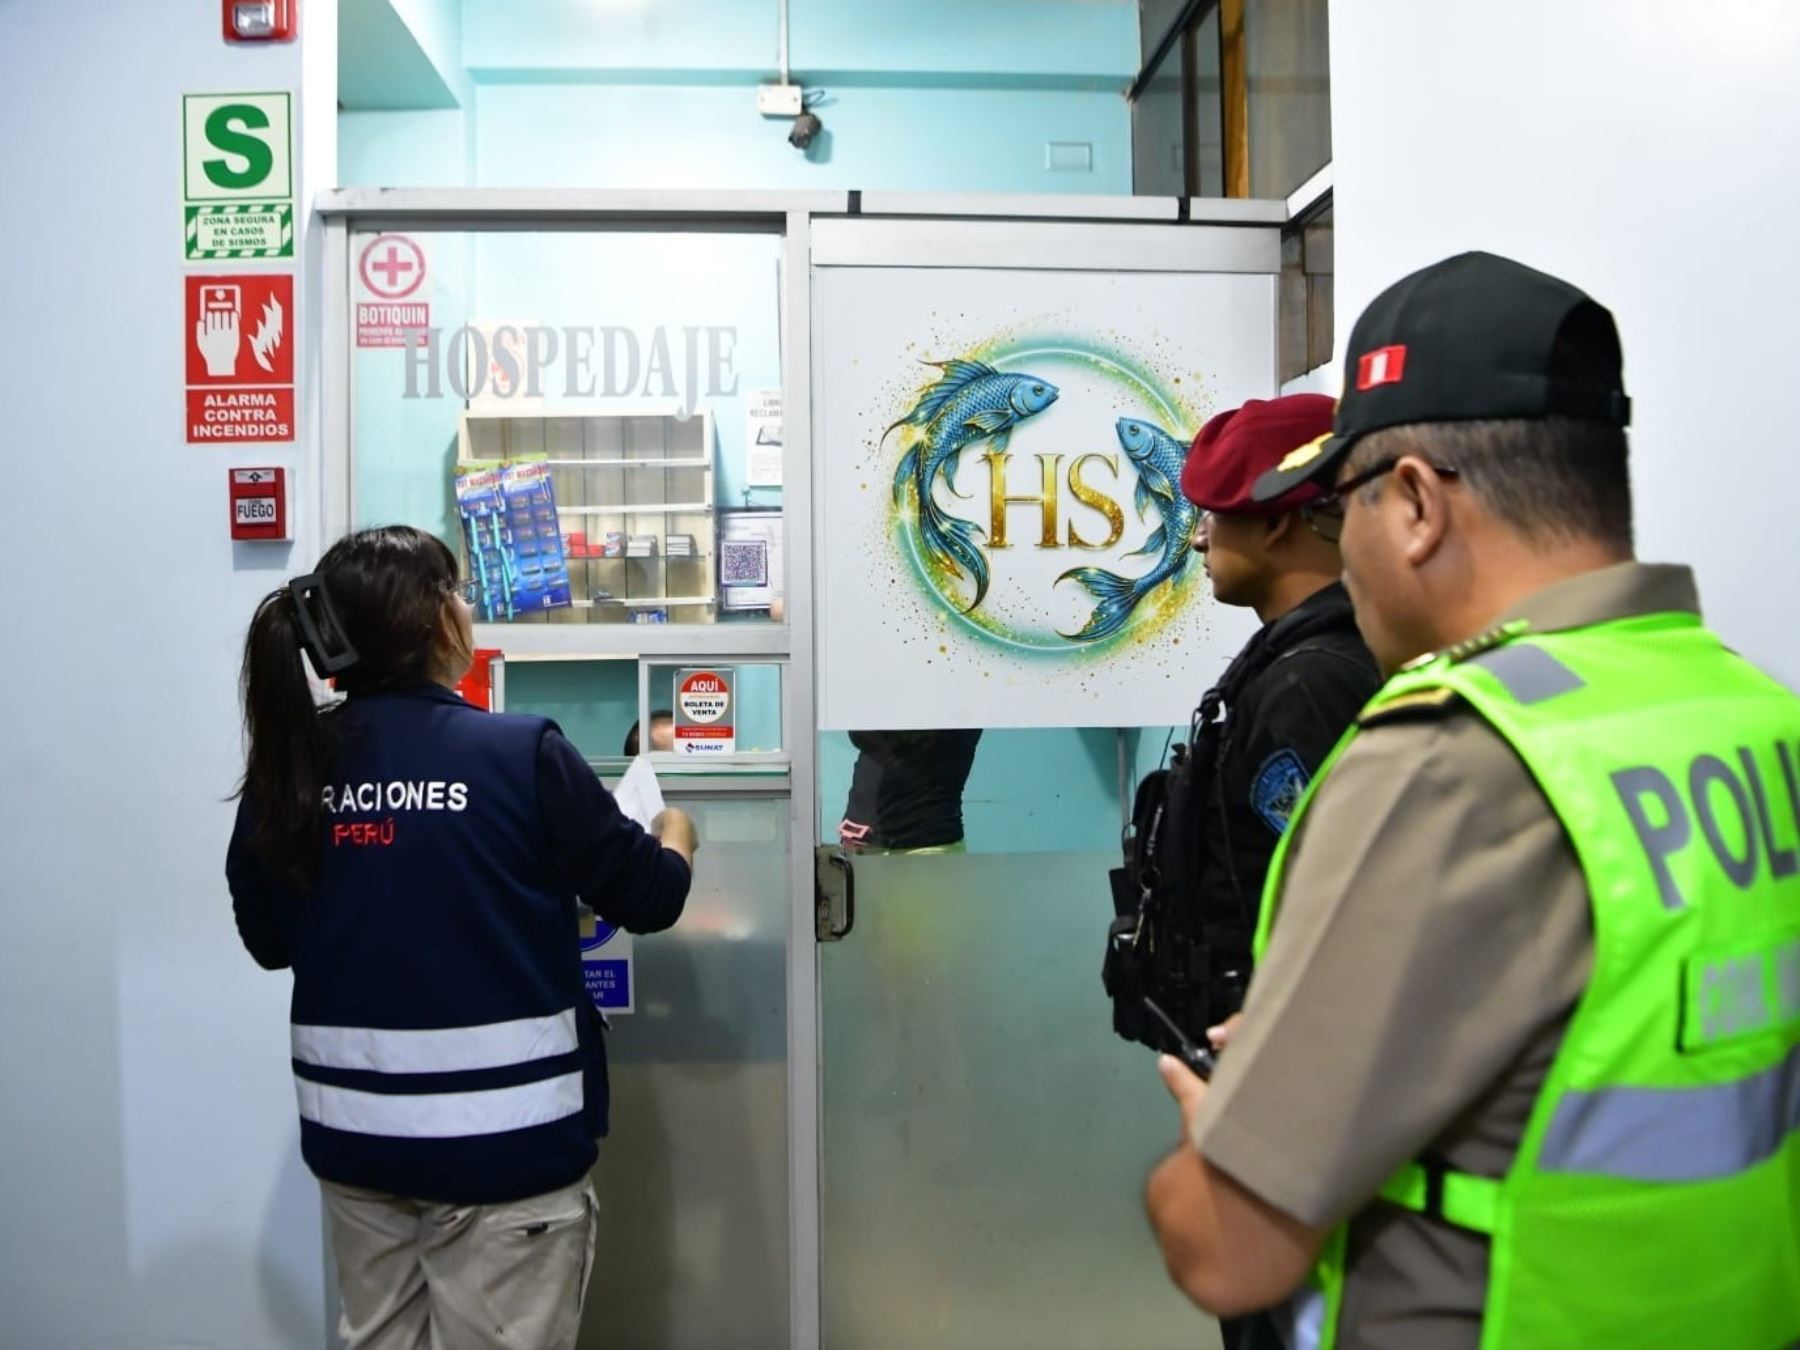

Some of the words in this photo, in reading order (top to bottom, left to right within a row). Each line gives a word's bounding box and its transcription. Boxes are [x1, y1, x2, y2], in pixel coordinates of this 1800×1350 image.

[202, 104, 273, 189] S
[203, 217, 231, 225] ZONA
[234, 215, 275, 224] SEGURA
[214, 228, 228, 236] EN
[230, 227, 264, 235] CASOS
[212, 239, 225, 247] DE
[228, 238, 267, 246] SISMOS
[359, 306, 426, 326] BOTIQUIN
[402, 325, 739, 422] HOSPEDAJE
[204, 394, 277, 407] ALARMA
[204, 409, 277, 422] CONTRA
[193, 424, 289, 437] INCENDIOS
[981, 453, 1125, 550] HS
[237, 504, 274, 518] FUEGO
[690, 678, 719, 692] AQUÍ
[321, 781, 469, 813] RACIONES
[1608, 737, 1800, 911] POLI
[333, 817, 395, 846] PERÚ
[584, 969, 602, 978] TAR
